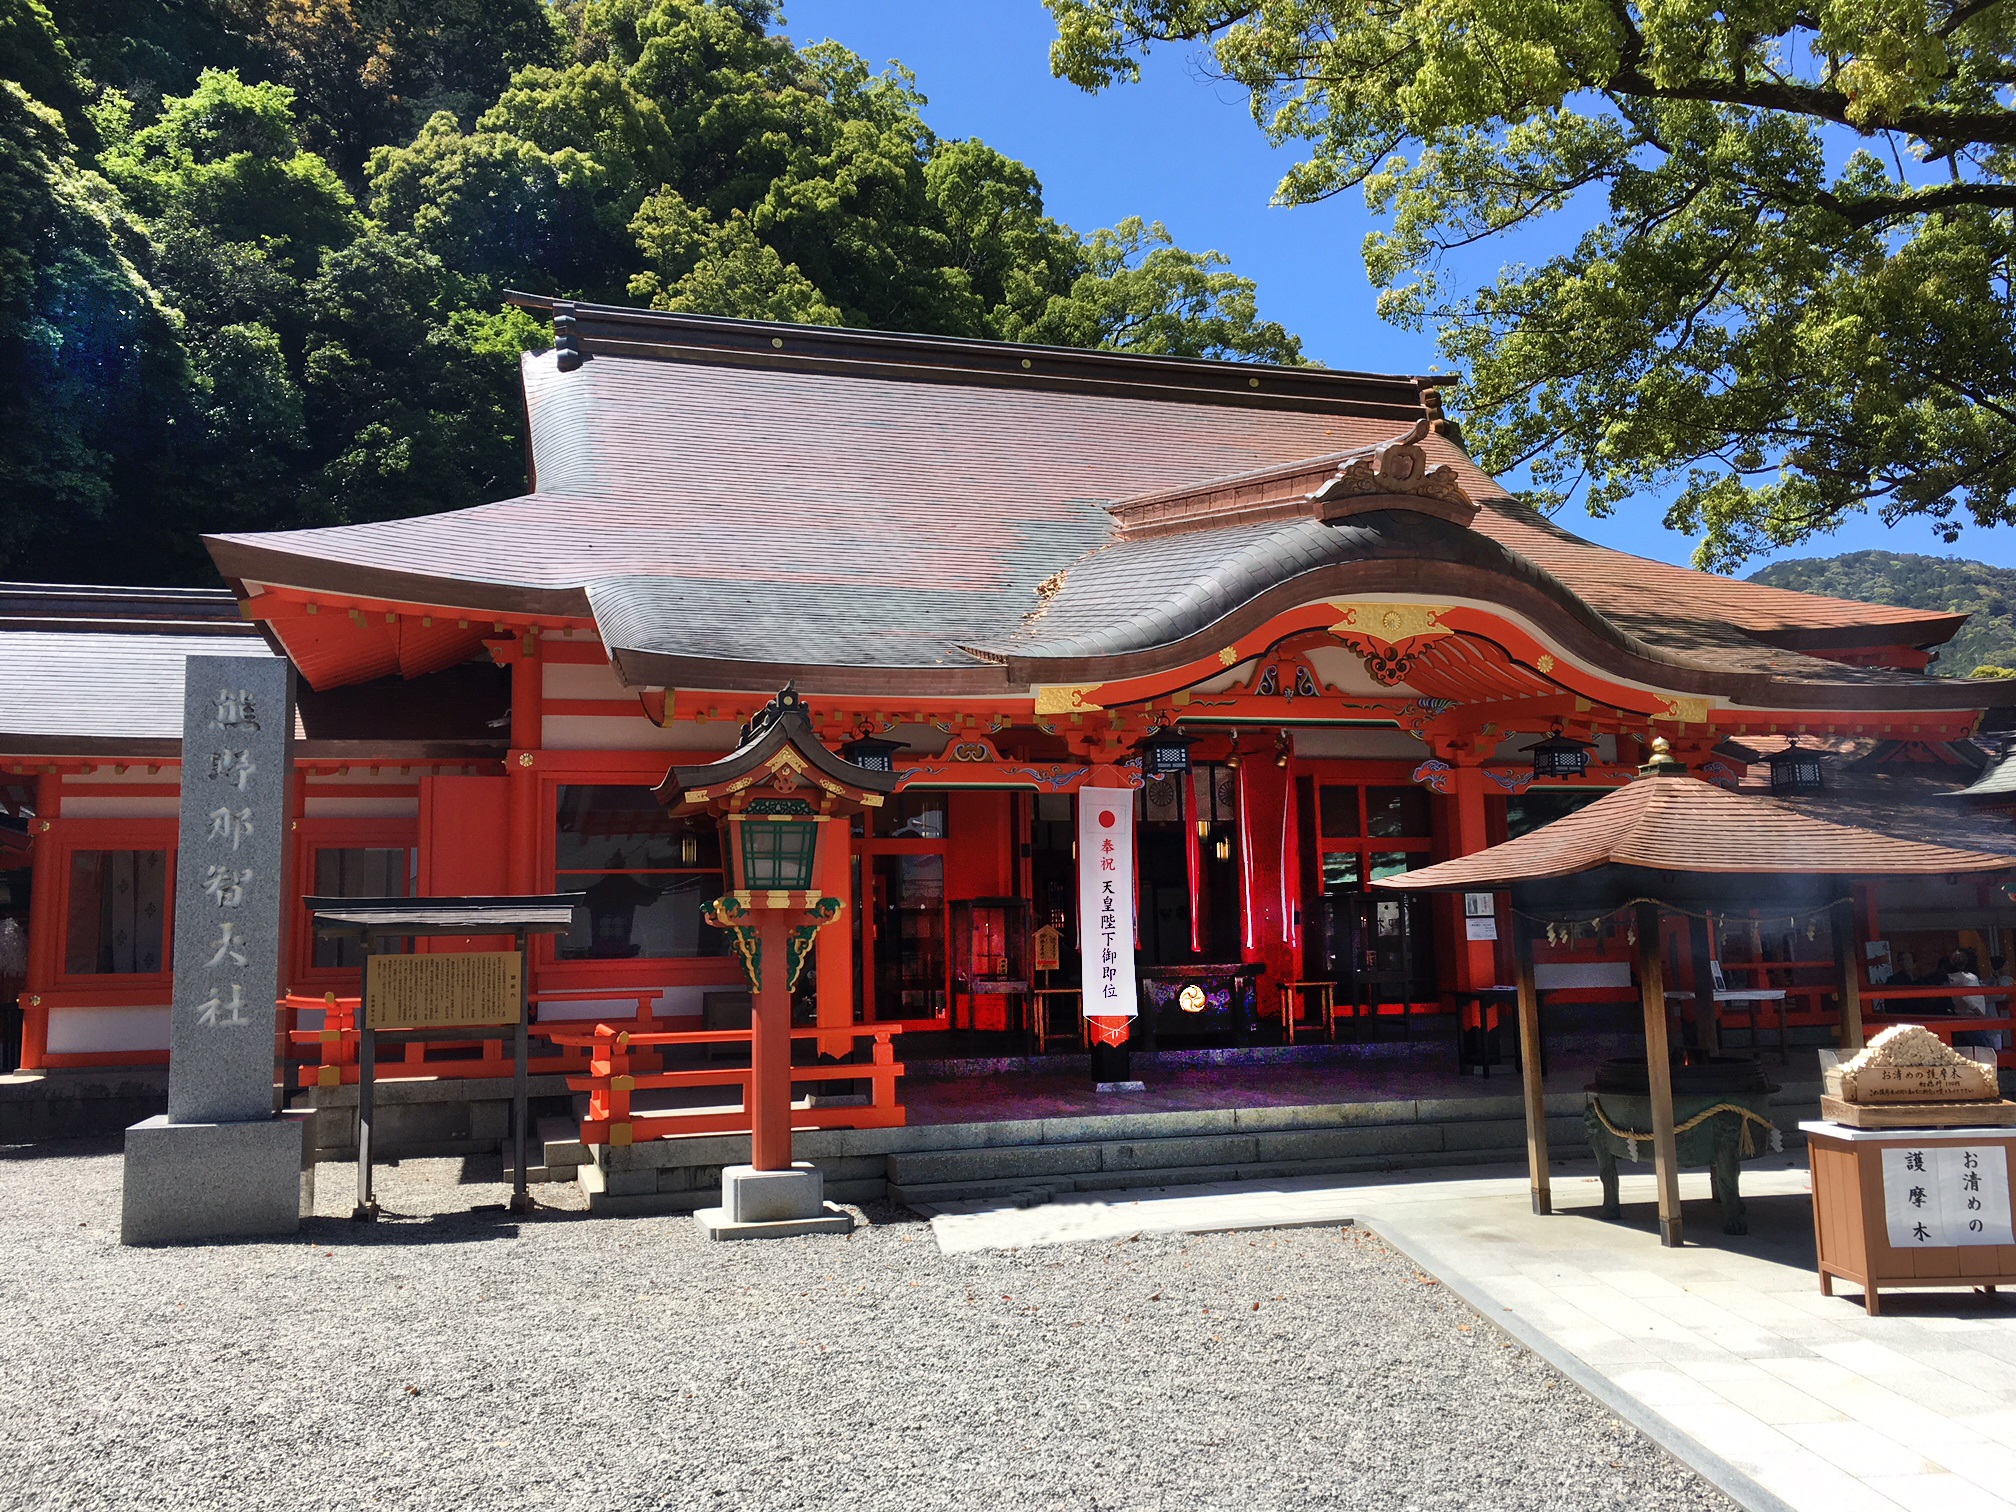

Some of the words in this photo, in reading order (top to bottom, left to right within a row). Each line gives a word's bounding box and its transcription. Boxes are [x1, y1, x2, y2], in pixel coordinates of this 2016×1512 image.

[196, 688, 261, 1028] 熊野那智大社
[1100, 838, 1116, 871] 奉祝
[1101, 880, 1118, 998] 天皇陛下御即位
[1882, 1067, 1963, 1080] お清めの護摩木
[1904, 1151, 1932, 1242] 護摩木
[1962, 1151, 1983, 1232] お清めの
